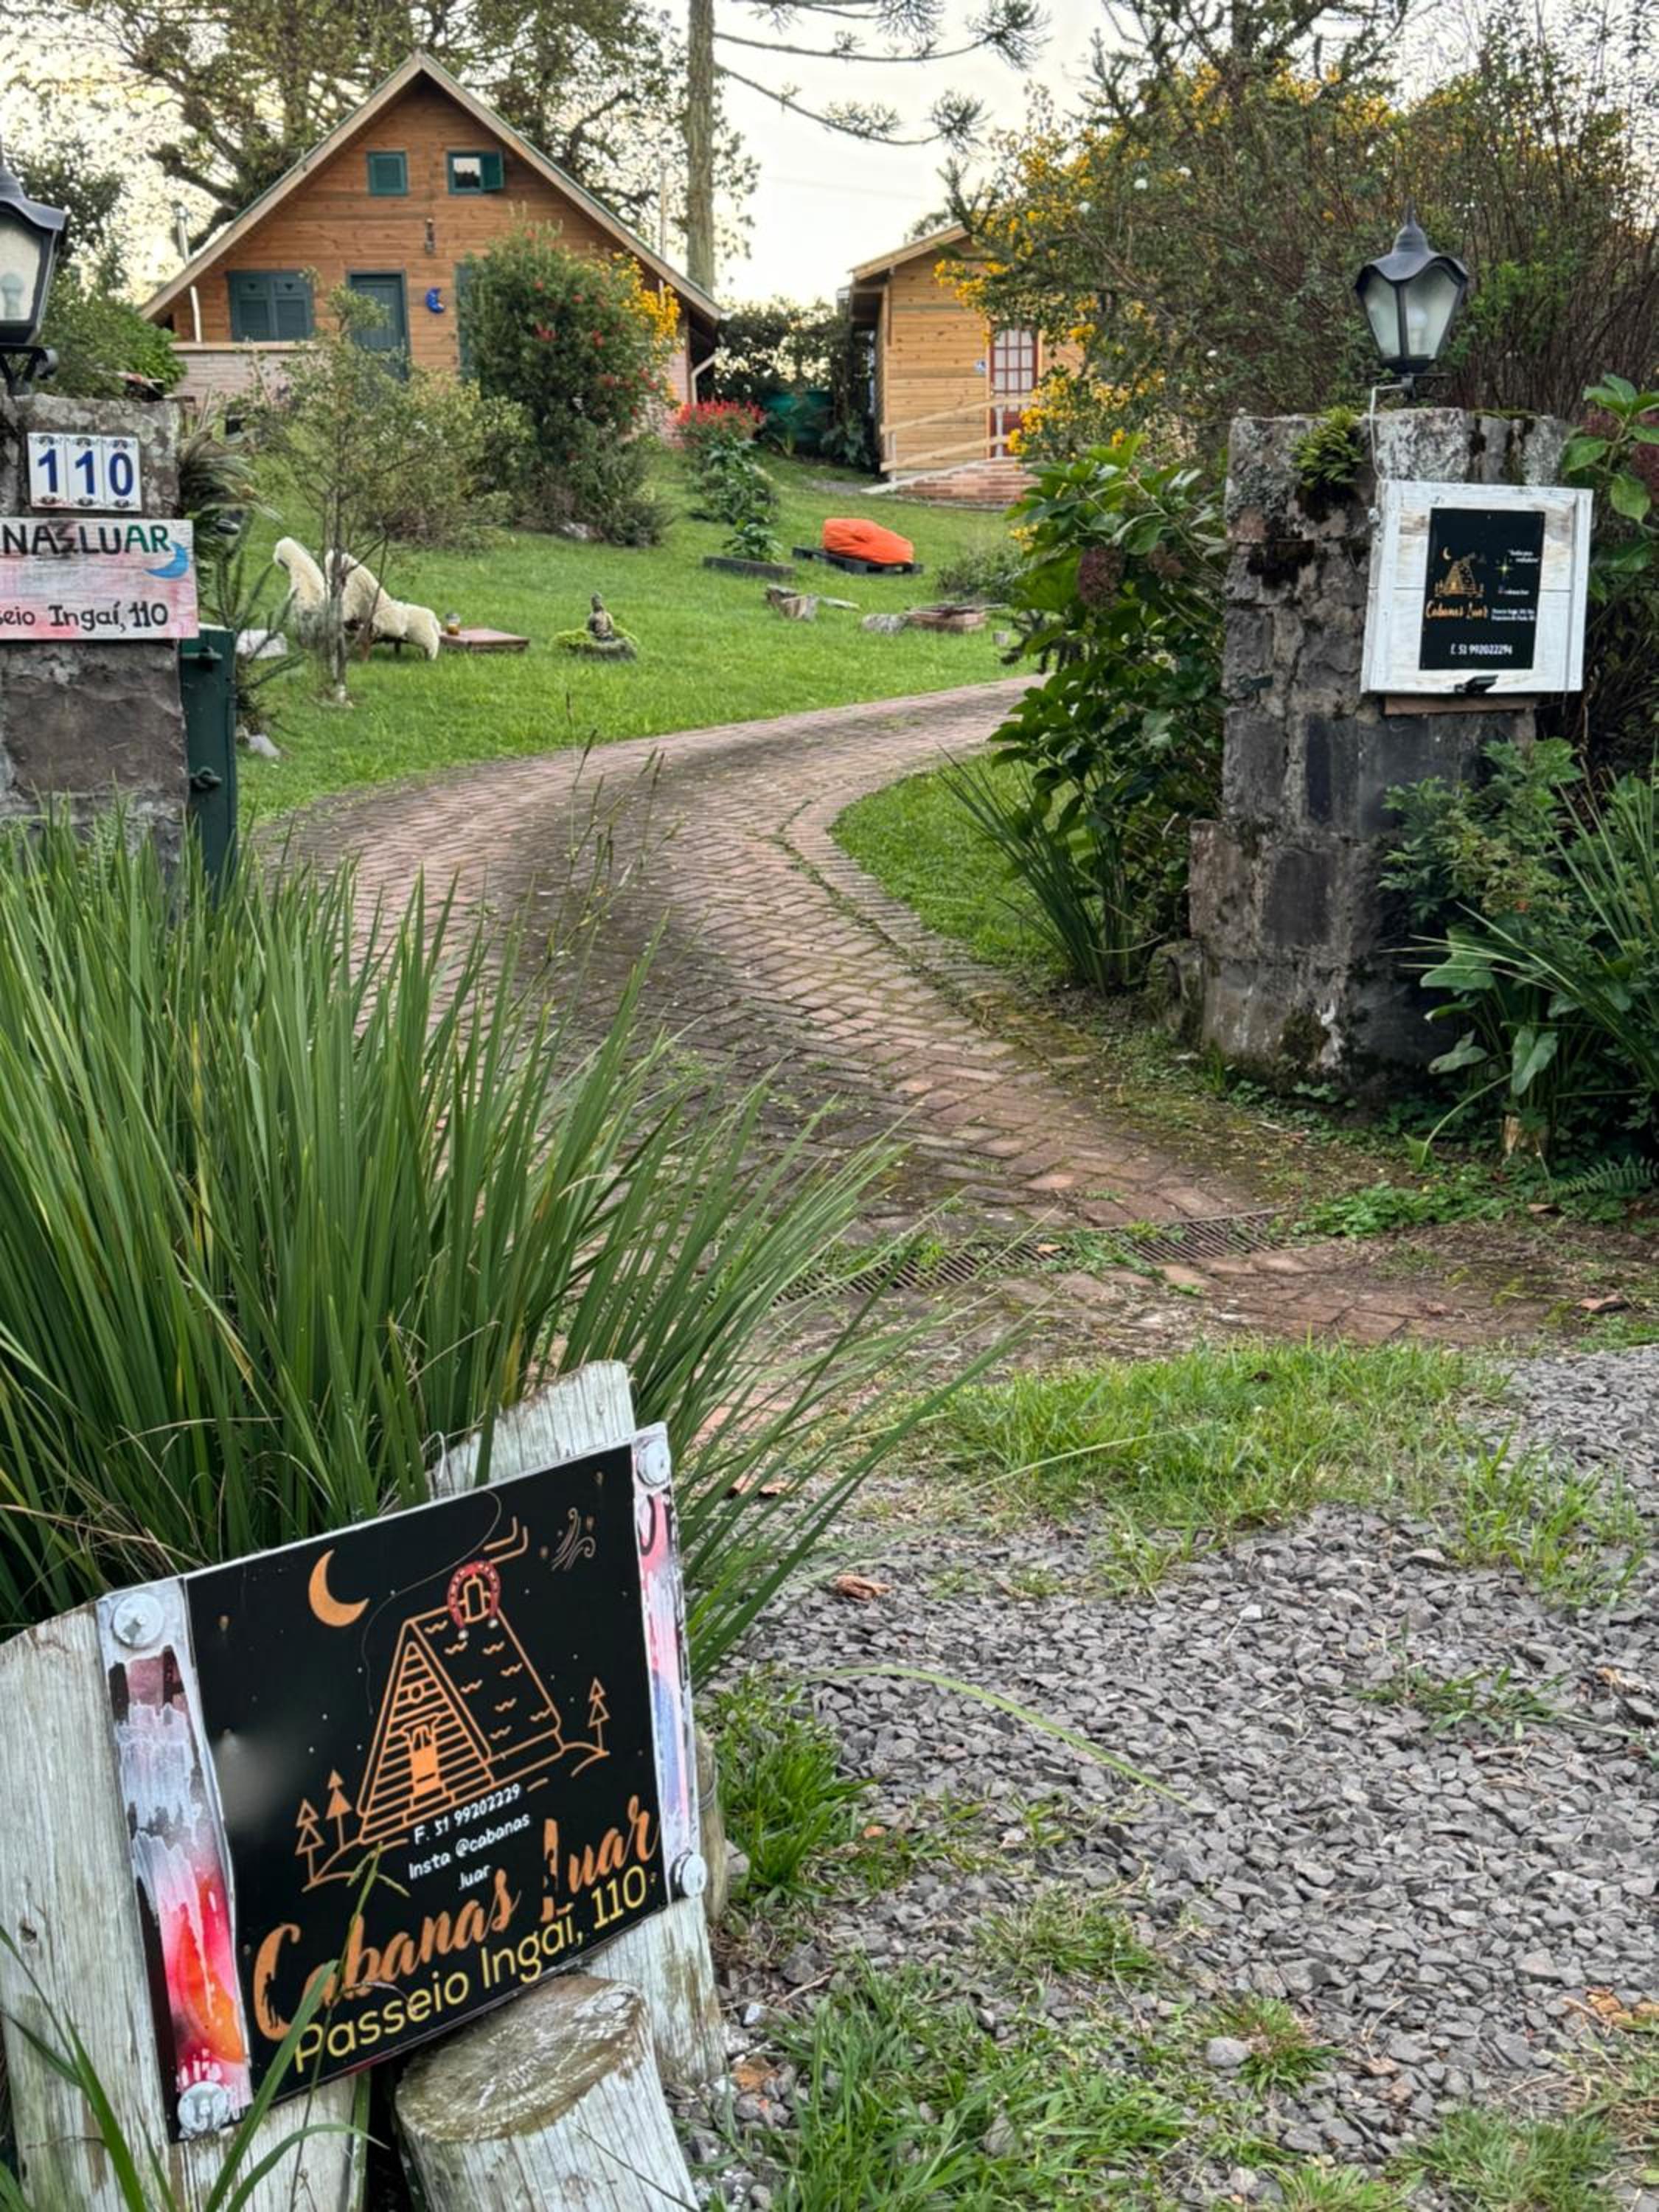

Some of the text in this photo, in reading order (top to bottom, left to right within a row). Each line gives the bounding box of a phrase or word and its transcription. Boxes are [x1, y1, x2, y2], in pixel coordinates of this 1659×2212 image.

[38, 448, 134, 496] 110
[48, 601, 127, 633] Ingaí,
[128, 601, 169, 627] 110
[414, 1824, 431, 1846] F.
[453, 1783, 521, 1826] 99202229
[408, 1813, 530, 1880] Insta @cabanas
[296, 1970, 470, 2073] Passeio
[591, 1865, 647, 1930] 110
